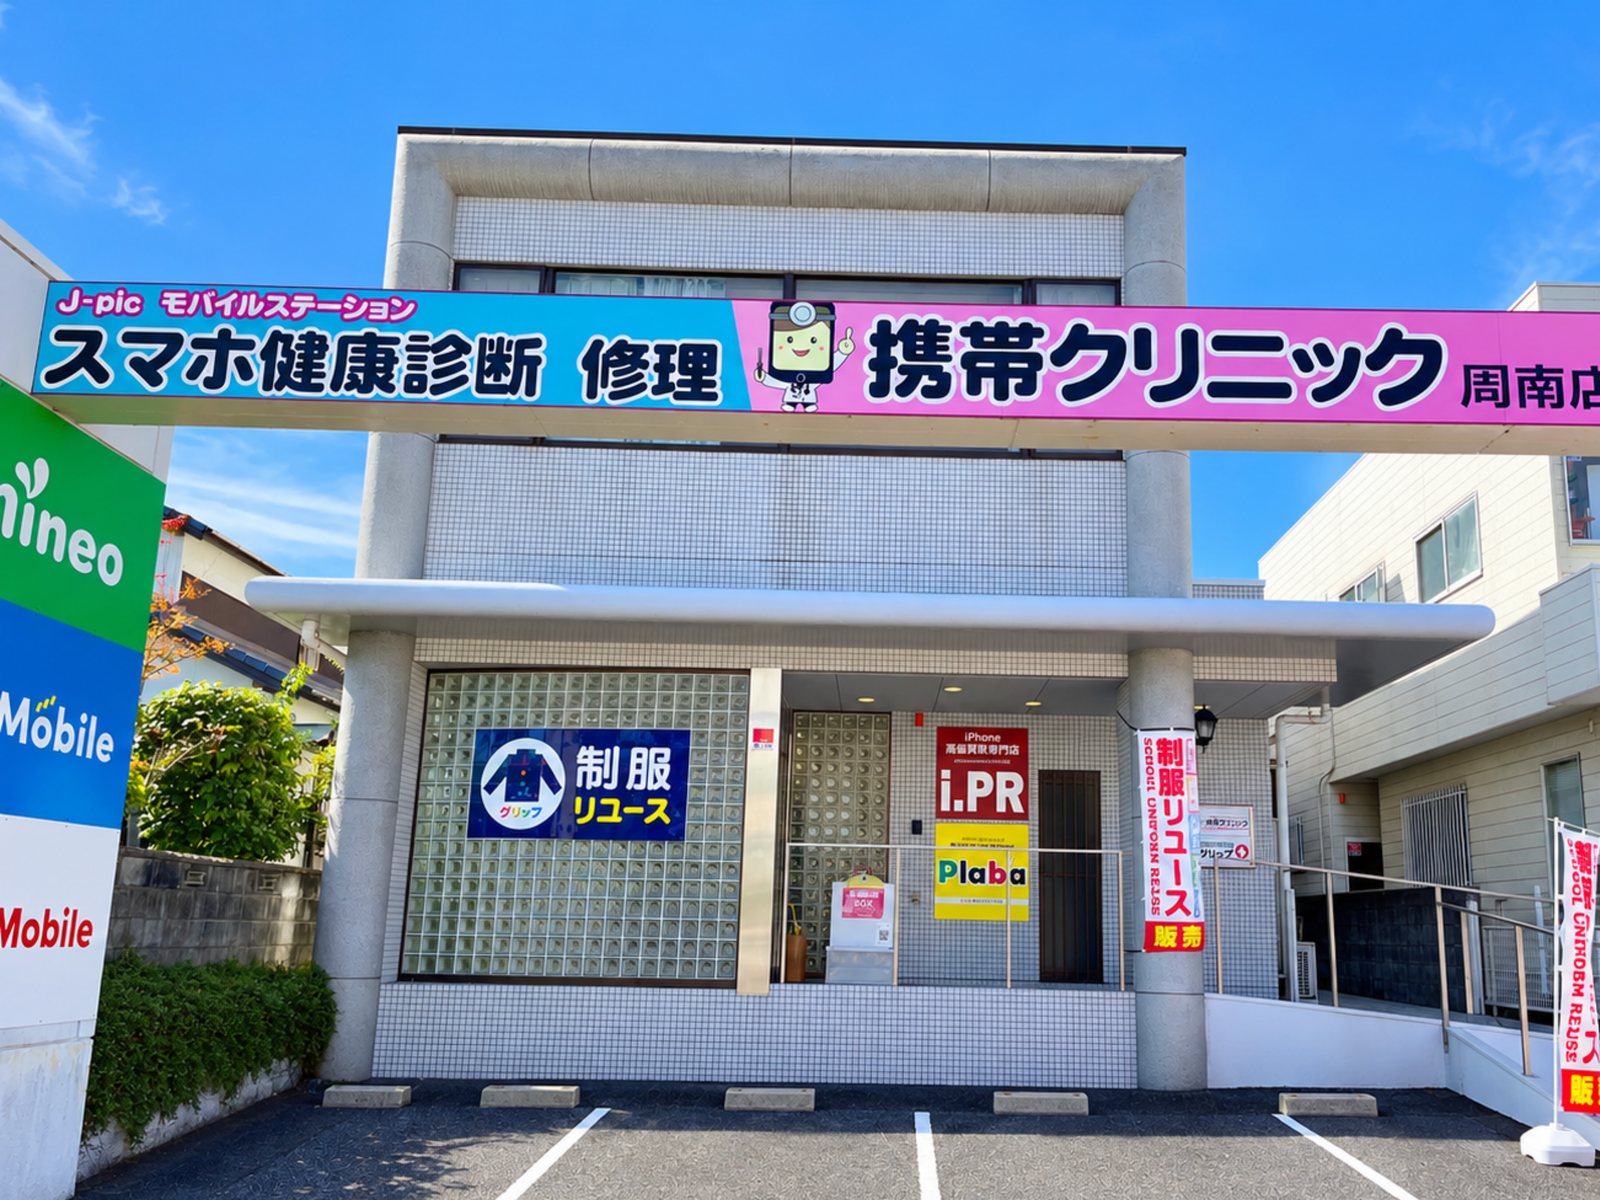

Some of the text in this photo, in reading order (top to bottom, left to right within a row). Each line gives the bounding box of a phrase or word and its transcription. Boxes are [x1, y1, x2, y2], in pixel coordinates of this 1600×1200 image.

[57, 288, 418, 323] J-pic モバイルステーション
[42, 326, 720, 404] スマホ健康診断 修理
[866, 315, 1447, 409] 携帯クリニック
[964, 731, 1002, 743] iPhone
[575, 745, 672, 791] 制服
[940, 769, 1025, 813] i.PR
[573, 796, 672, 825] リユース
[1156, 737, 1192, 918] 制服リユース
[938, 858, 1027, 887] Plaba
[1153, 924, 1202, 948] 販売
[1570, 1073, 1600, 1106] 販
